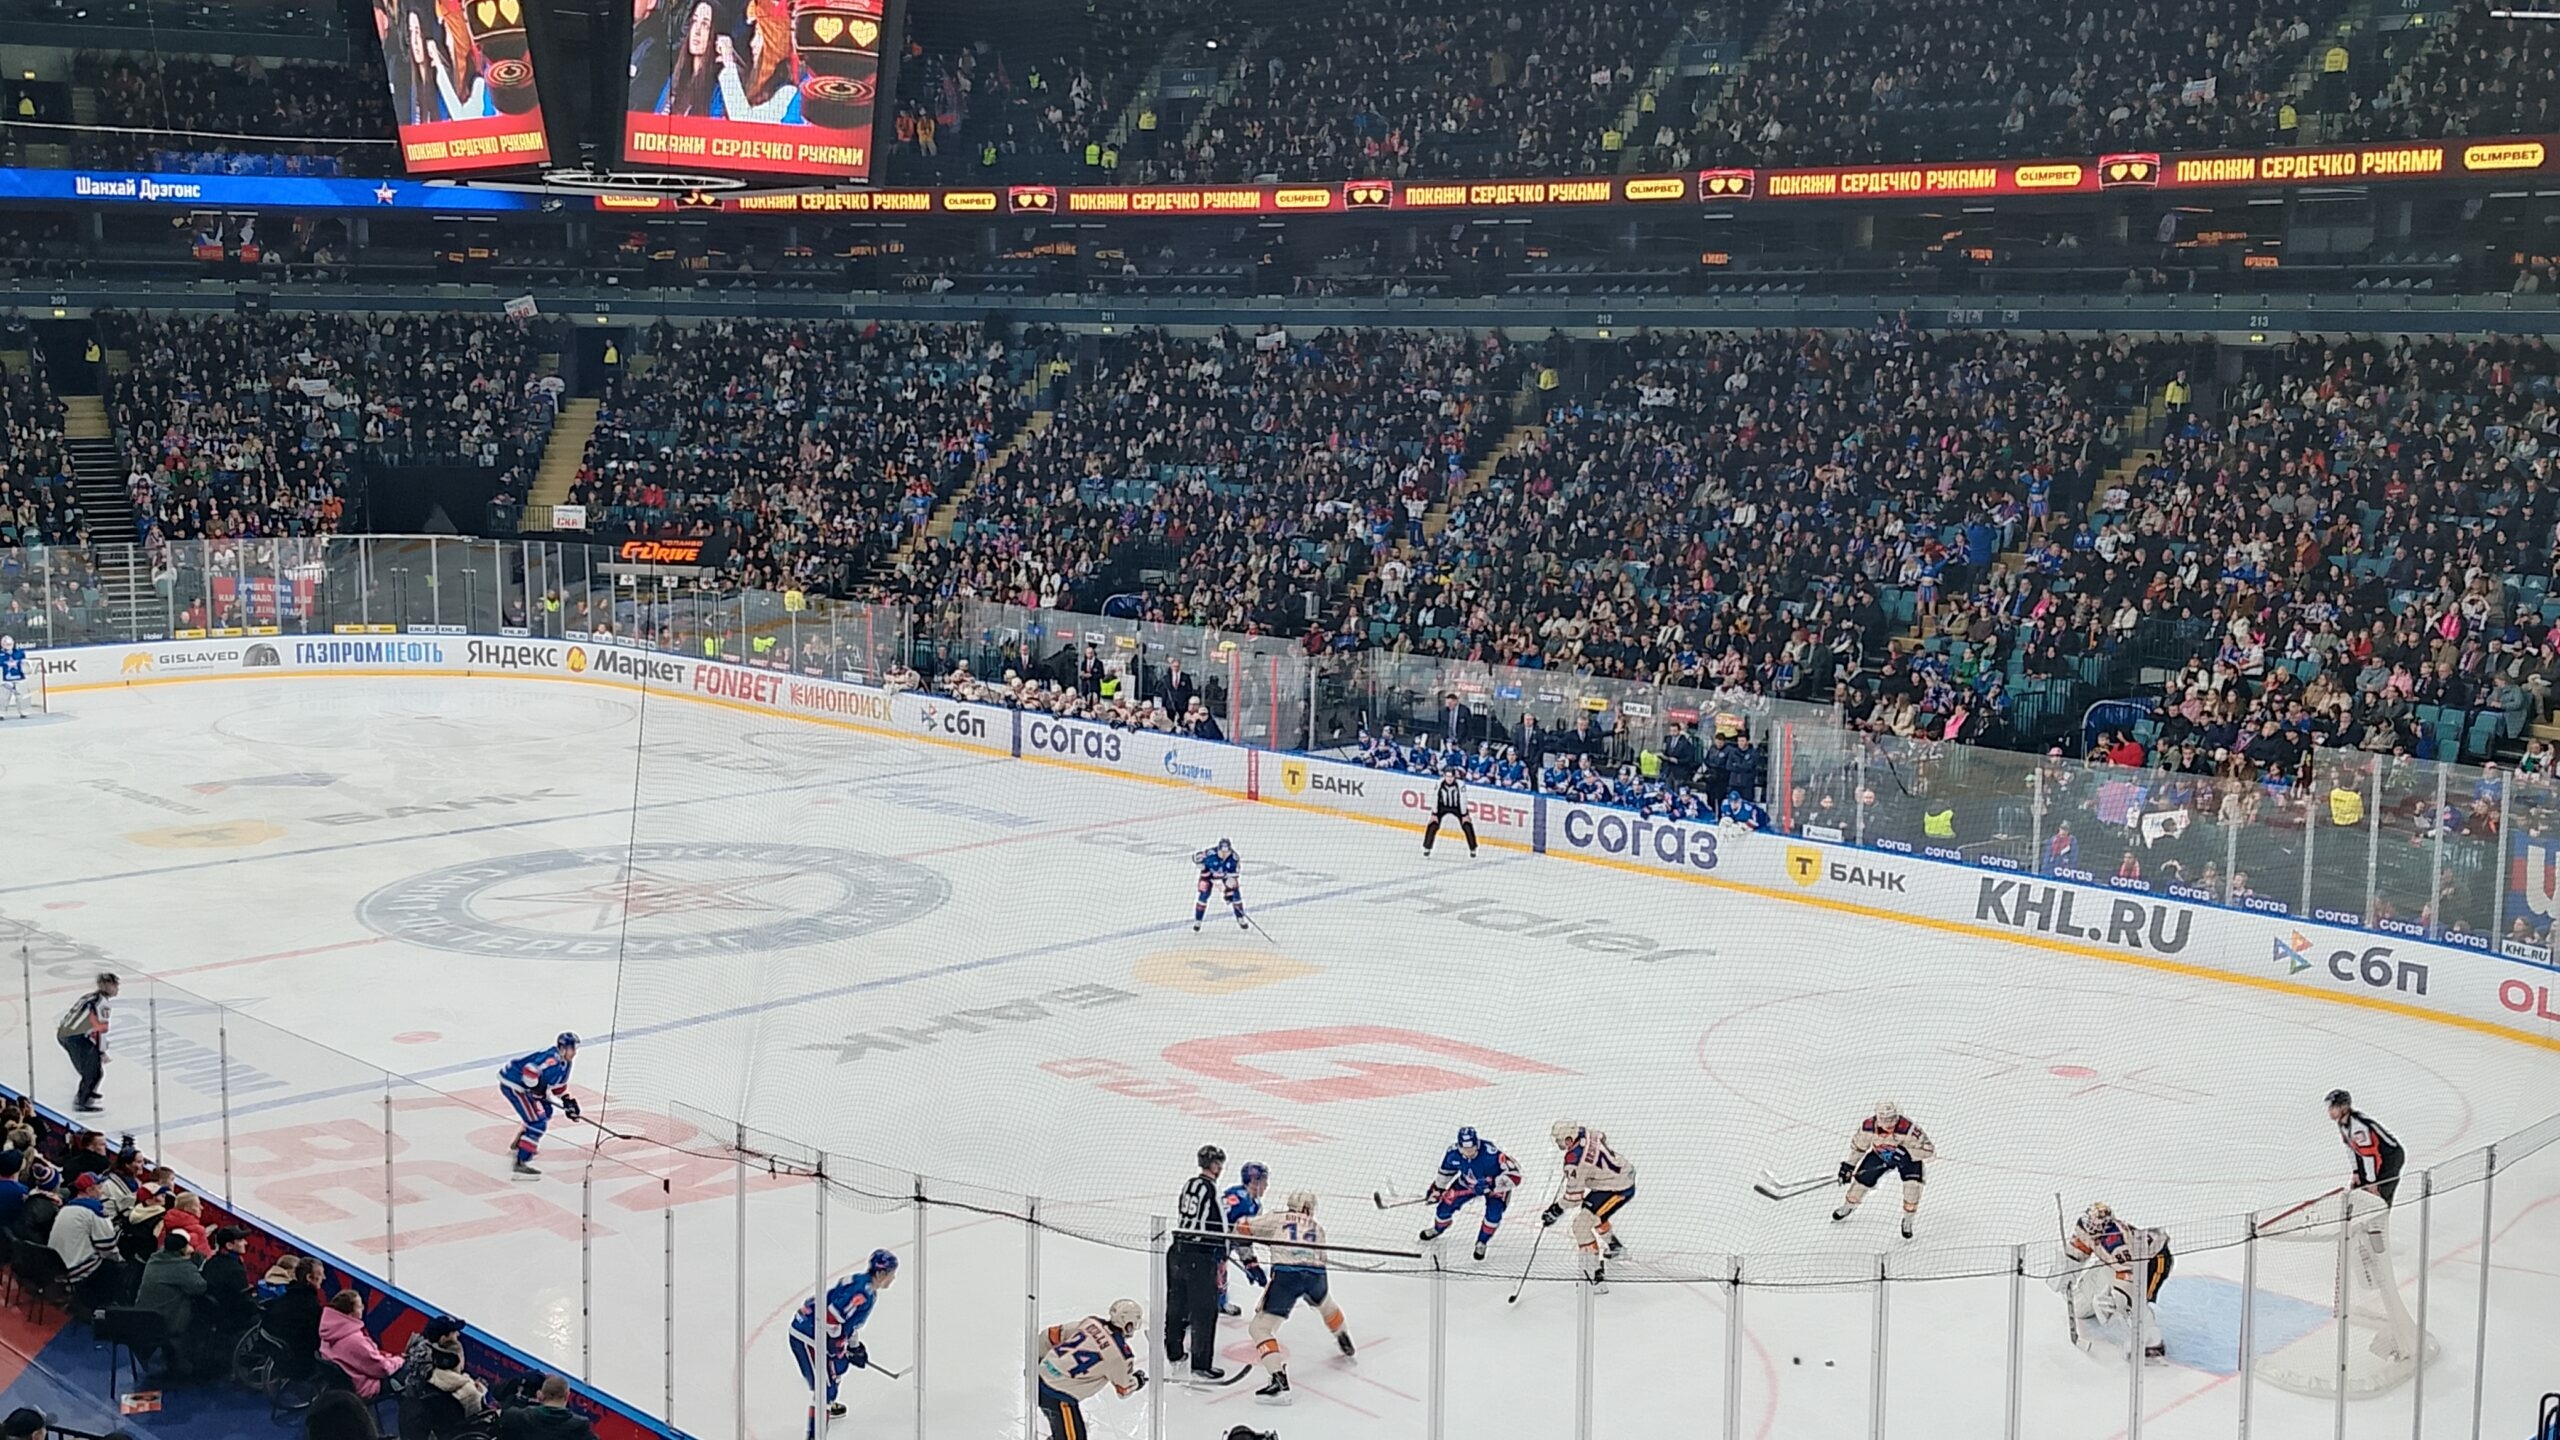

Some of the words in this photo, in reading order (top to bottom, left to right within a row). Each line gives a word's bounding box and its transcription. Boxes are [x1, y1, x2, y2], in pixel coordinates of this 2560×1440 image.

[407, 141, 448, 161] ПОКАЖИ
[449, 136, 499, 157] СЕРДЕЧКО
[500, 131, 544, 153] РУКАМИ
[634, 131, 706, 156] ПОКАЖИ
[711, 138, 793, 161] СЕРДЕЧКО
[798, 144, 864, 166] РУКАМИ
[2470, 149, 2540, 164] OLIMPBET
[2020, 170, 2078, 182] OLIMPBET
[2177, 158, 2255, 182] ПОКАЖИ
[2261, 153, 2356, 179] СЕРДЕЧКО
[2361, 149, 2443, 174] РУКАМИ
[75, 176, 136, 196] Шанхай
[139, 180, 201, 200] Дрэгонс
[1406, 185, 1466, 206] ПОКАЖИ
[1471, 183, 1544, 205] СЕРДЕЧКО
[1548, 182, 1611, 203] РУКАМИ
[1629, 183, 1680, 195] OLIMPBET
[1769, 174, 1836, 196] ПОКАЖИ
[1840, 171, 1921, 193] СЕРДЕЧКО
[1926, 169, 1996, 191] РУКАМИ
[740, 196, 797, 210] ПОКАЖИ
[801, 194, 869, 210] СЕРДЕЧКО
[873, 194, 930, 210] РУКАМИ
[948, 197, 993, 207] OLIMPBET
[1070, 193, 1128, 210] ПОКАЖИ
[1132, 192, 1199, 210] СЕРДЕЧКО
[1203, 191, 1260, 209] РУКАМИ
[1279, 193, 1325, 204] OLIMPBET
[595, 303, 610, 312] 210
[1597, 314, 1612, 325] 212
[2250, 315, 2269, 327] 213
[143, 632, 164, 640] Haier
[409, 626, 435, 634] KHL.RU
[440, 626, 466, 634] KHL.RU
[159, 651, 239, 665] GISLAVED
[296, 641, 443, 664] ГАЗПРОМНЕФТЬ
[467, 640, 558, 668] Яндекс
[593, 649, 685, 684] Маркет
[693, 664, 783, 705] FONBET
[944, 710, 986, 739] сбп
[1311, 774, 1364, 797] БАНК
[303, 788, 583, 827] БАНК
[1402, 790, 1528, 827] OLPBET
[1829, 862, 1906, 893] БАНК
[1366, 887, 1717, 963] Haier
[1975, 877, 2193, 954] KHL.RU
[2504, 943, 2549, 962] KHL.RU
[2328, 947, 2429, 996] сбп
[1053, 1331, 1103, 1379] 24
